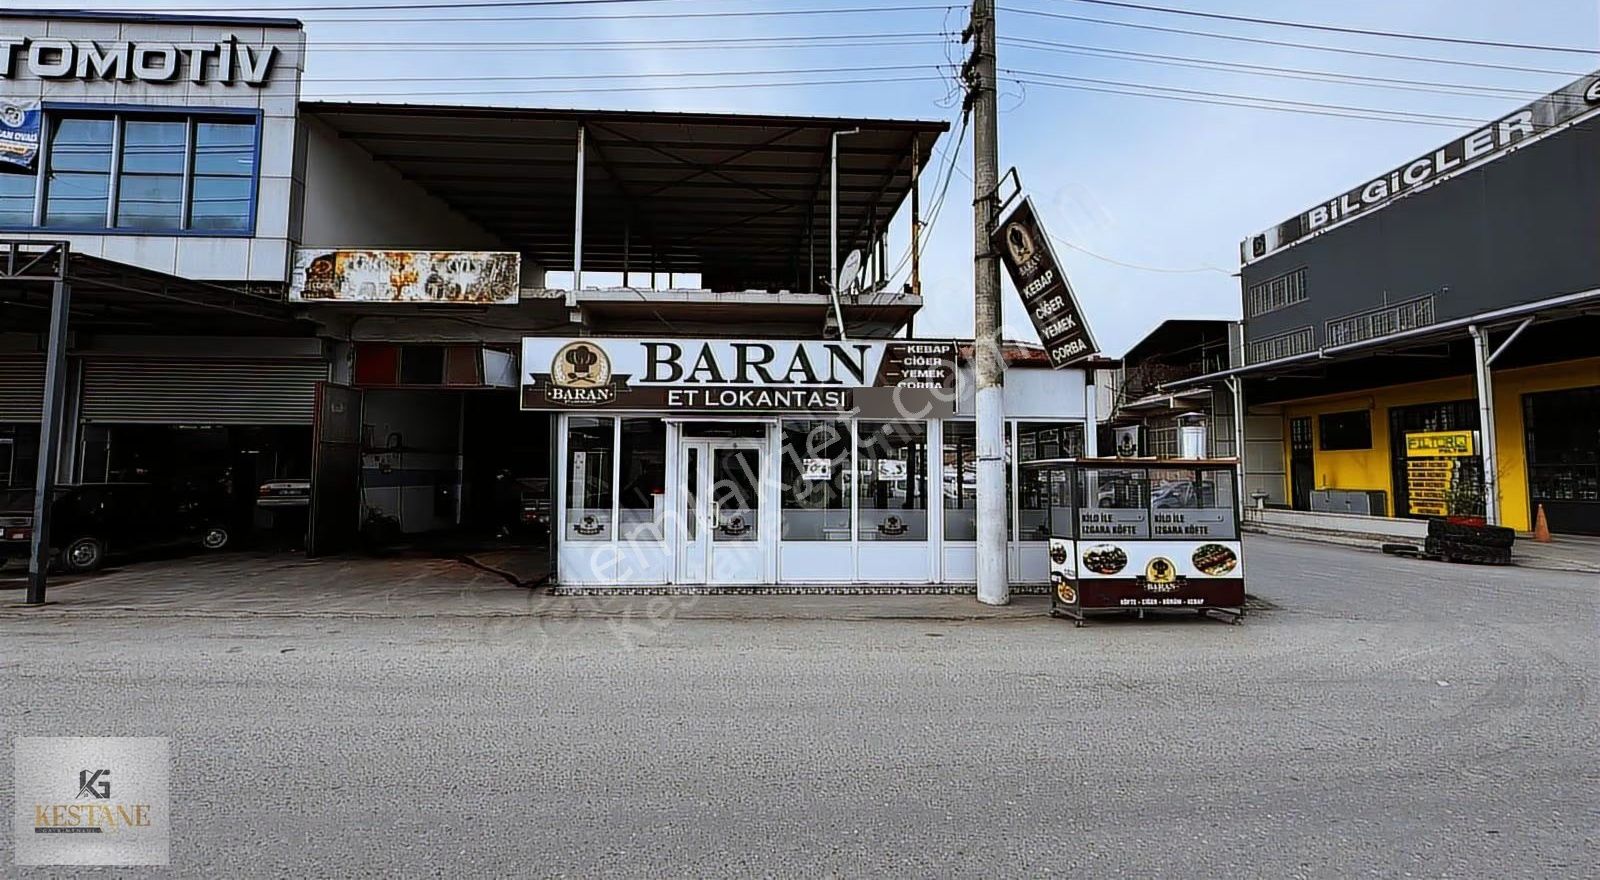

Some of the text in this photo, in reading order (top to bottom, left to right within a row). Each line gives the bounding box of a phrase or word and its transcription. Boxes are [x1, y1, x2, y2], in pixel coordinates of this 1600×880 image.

[1023, 270, 1054, 299] KEBAP
[1041, 313, 1077, 340] YEMEK
[907, 344, 950, 354] KEBAP
[1052, 338, 1087, 364] ÇORBA
[639, 341, 873, 385] BARAN
[901, 369, 945, 378] YEMEK
[552, 388, 609, 400] BARAN
[668, 390, 846, 408] ET LOKANTASI
[1112, 524, 1137, 535] KÖFTE
[1184, 524, 1208, 535] KÖFTE
